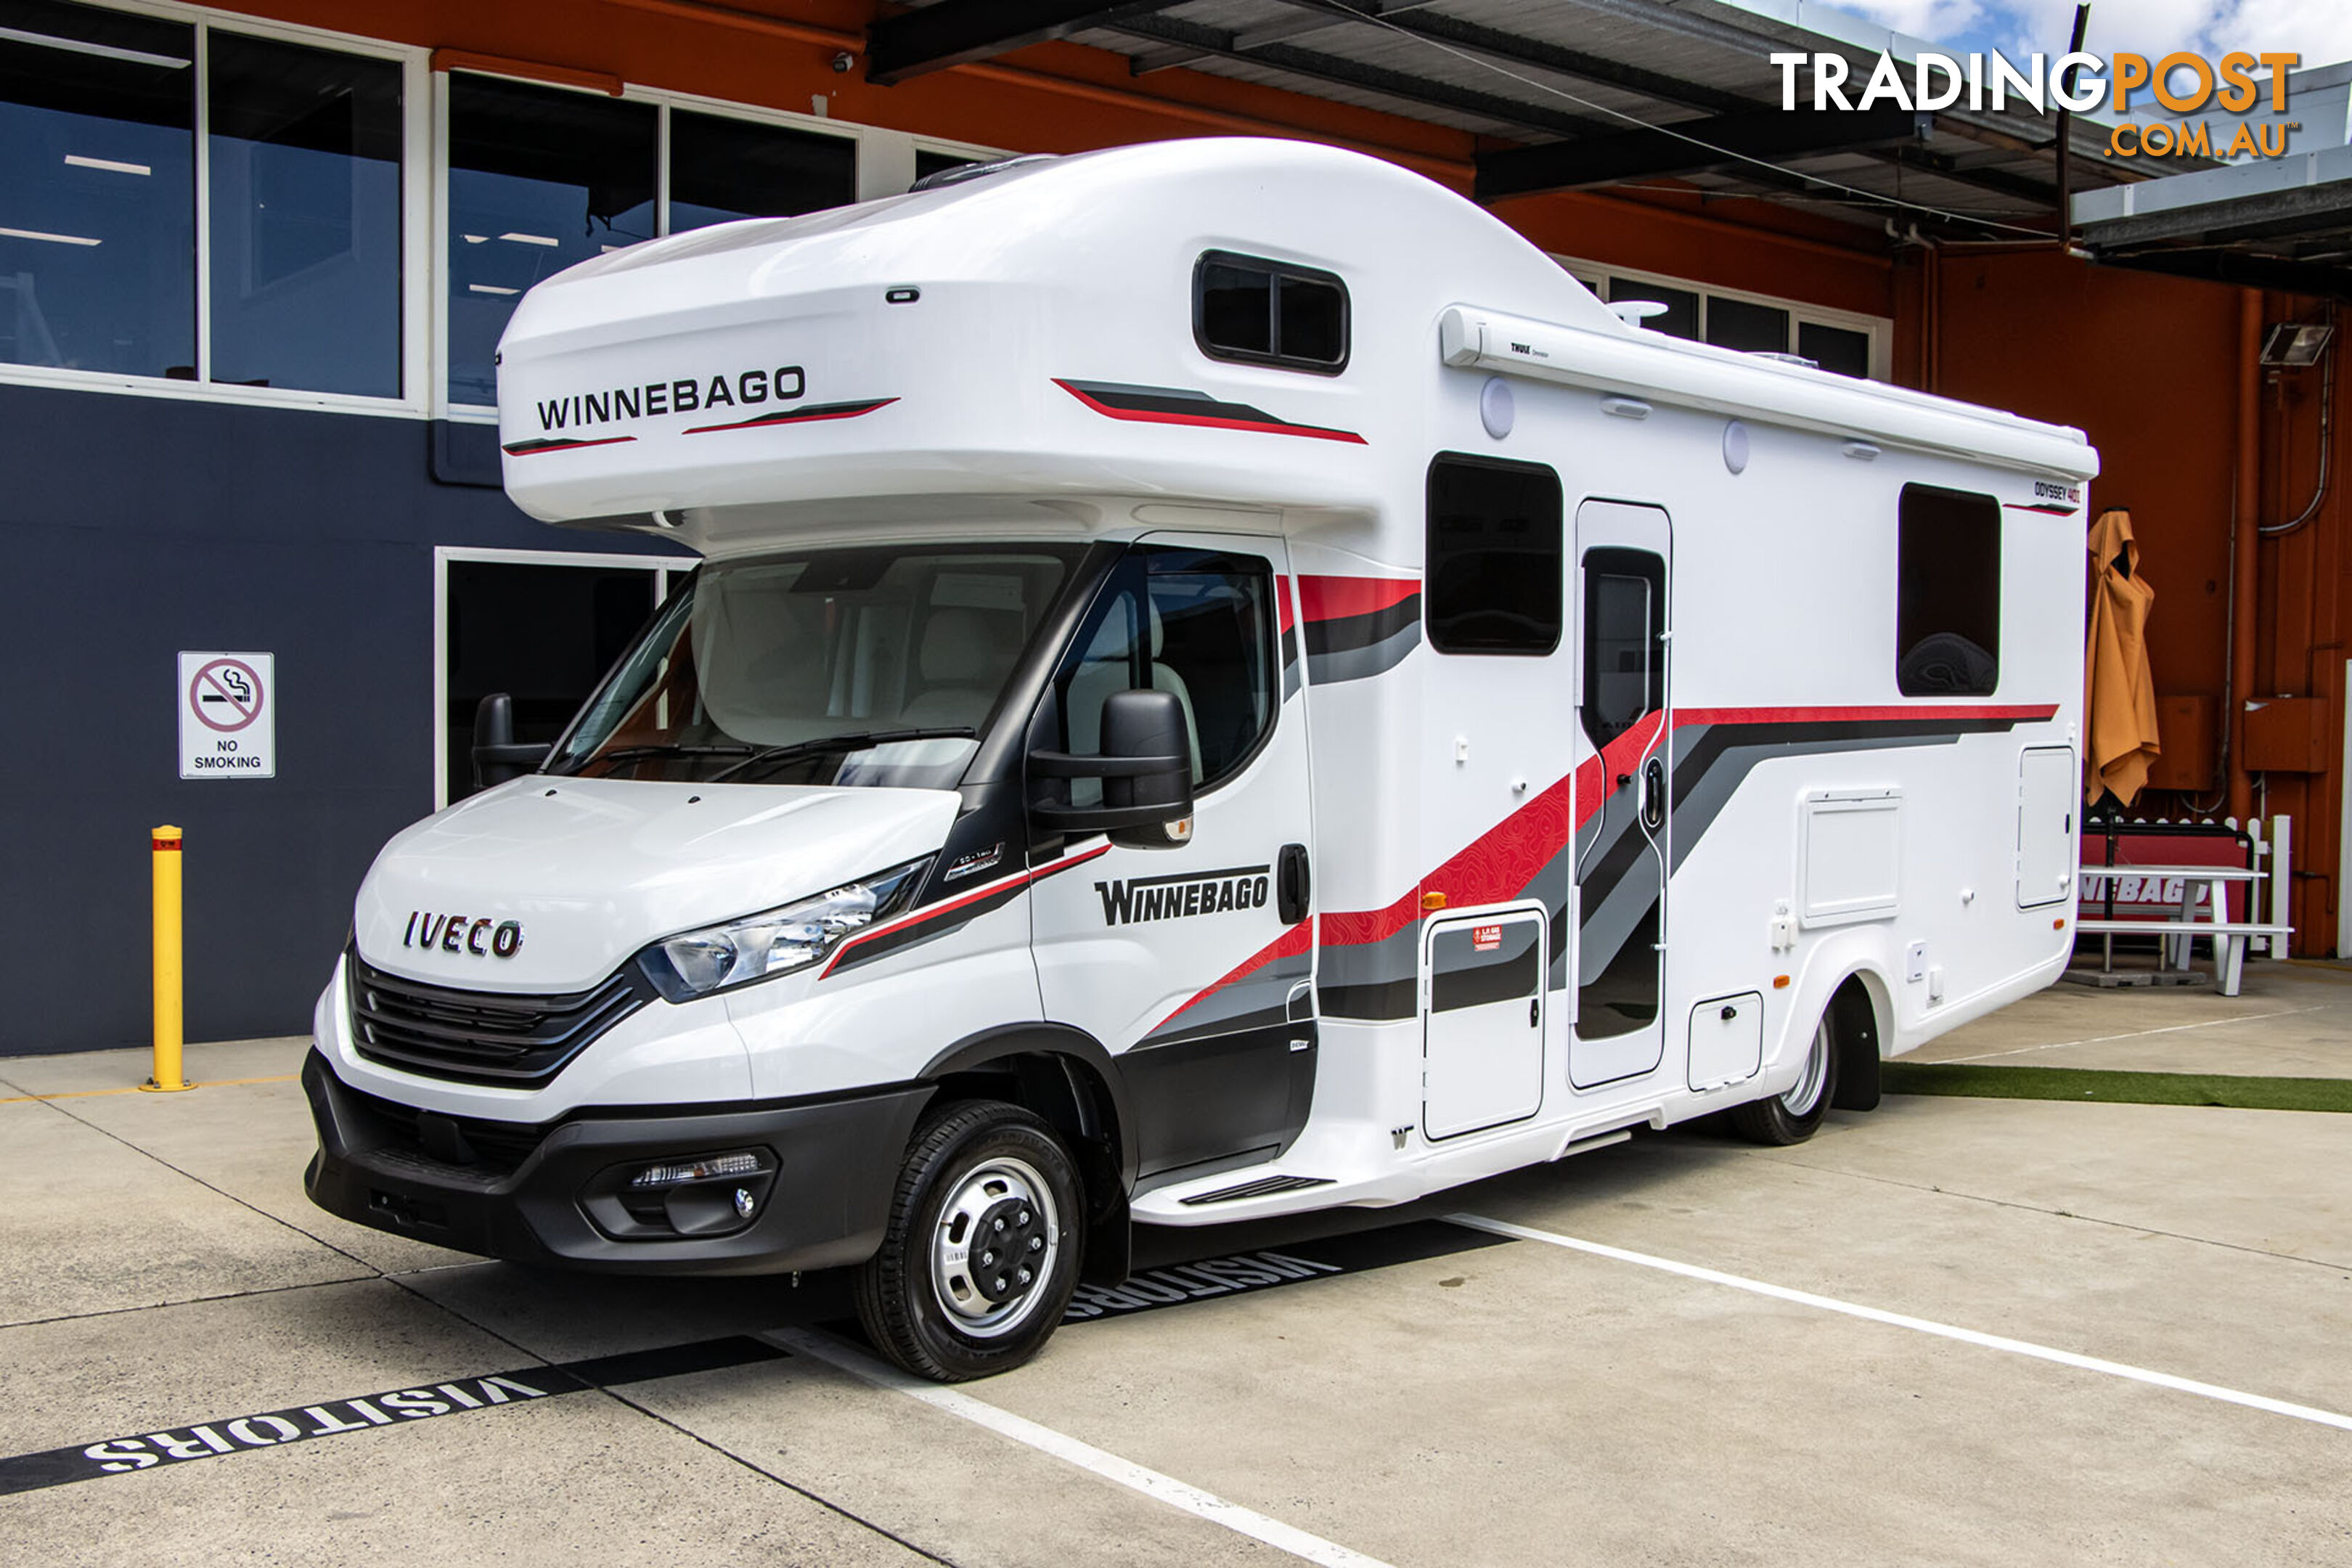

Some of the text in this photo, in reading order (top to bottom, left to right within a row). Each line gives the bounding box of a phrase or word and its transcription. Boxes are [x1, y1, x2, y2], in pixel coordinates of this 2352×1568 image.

[537, 365, 807, 430] WINNEBAGO
[2035, 481, 2067, 500] ODYSSEY
[195, 756, 261, 768] SMOKING
[218, 740, 237, 751] NO
[1093, 864, 1271, 926] WINNEBAGO
[403, 911, 525, 959] IVECO
[83, 1376, 549, 1473] VISITORS
